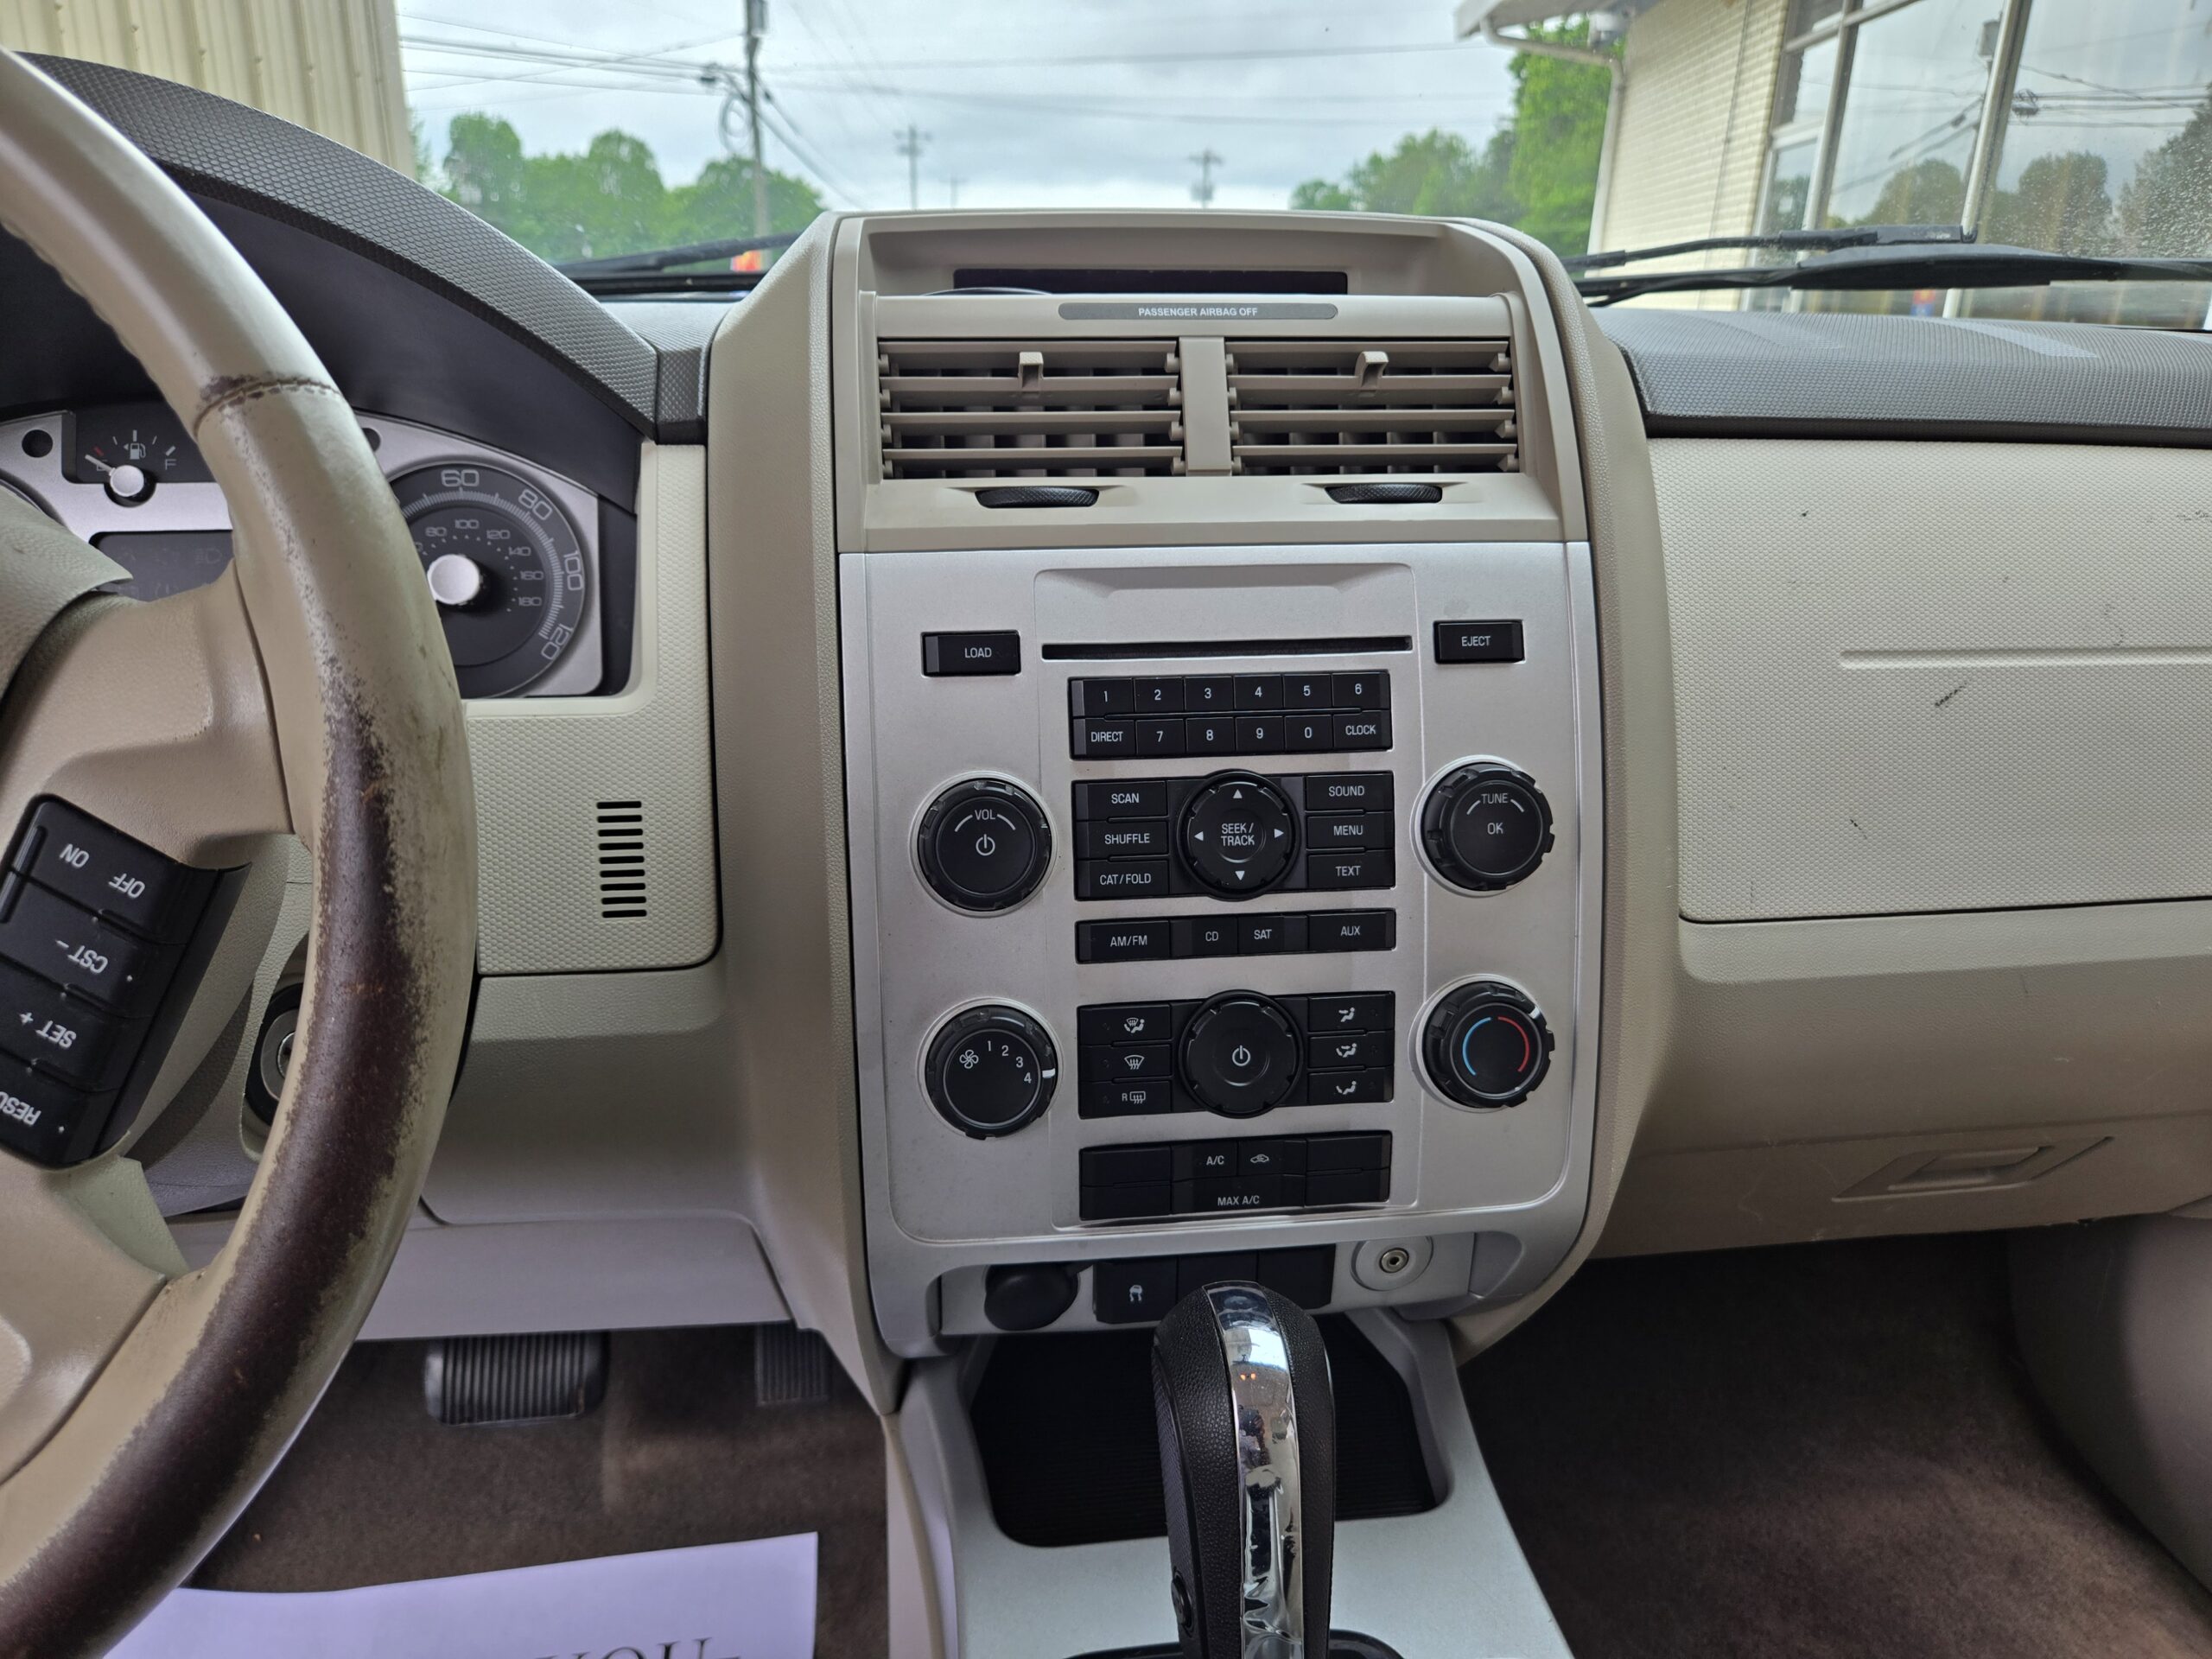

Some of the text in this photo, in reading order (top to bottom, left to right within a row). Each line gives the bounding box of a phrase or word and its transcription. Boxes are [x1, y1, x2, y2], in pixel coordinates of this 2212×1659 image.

[1138, 307, 1258, 317] PASSENGER AIRBAG OFF
[165, 458, 177, 470] F
[441, 469, 480, 487] 60
[518, 488, 553, 520] 80
[454, 519, 480, 530] 100
[425, 526, 447, 537] 80
[486, 529, 511, 539] 120
[508, 546, 531, 556] 140
[519, 570, 544, 581] 160
[563, 550, 584, 591] 100
[518, 597, 543, 606] 180
[540, 623, 574, 660] 120
[1461, 635, 1491, 647] EJECT
[964, 647, 993, 658] LOAD
[1154, 689, 1161, 701] 2
[1204, 687, 1212, 699] 3
[1255, 686, 1262, 697] 4
[1303, 684, 1311, 696] 5
[1354, 683, 1363, 696] 6
[1156, 730, 1164, 742] 7
[1205, 728, 1214, 741] 8
[1255, 727, 1264, 740] 9
[1304, 727, 1313, 739] 0
[1344, 724, 1376, 736] CLOCK
[1090, 731, 1124, 742] DIRECT
[1328, 785, 1365, 798] SOUND
[1111, 792, 1140, 804] SCAN
[1481, 792, 1510, 804] TUNE
[974, 809, 996, 821] VOL
[1333, 824, 1363, 836] MENU
[1487, 822, 1503, 836] OK
[1104, 832, 1151, 845] SHUFFLE
[1220, 834, 1255, 847] TRACK
[59, 843, 90, 868] ON
[1335, 865, 1362, 877] TEXT
[108, 873, 146, 899] OFF
[1205, 931, 1219, 942] CD
[1254, 929, 1273, 940] SAT
[1340, 925, 1361, 937] AUX
[1109, 934, 1147, 947] AM/FM
[67, 944, 109, 975] CST
[35, 1020, 77, 1049] SET
[1001, 1045, 1009, 1057] 2
[1015, 1056, 1024, 1068] 3
[1023, 1071, 1033, 1084] 4
[1122, 1092, 1128, 1102] R
[1205, 1154, 1224, 1166] A/C
[1217, 1195, 1261, 1206] MAX A/C
